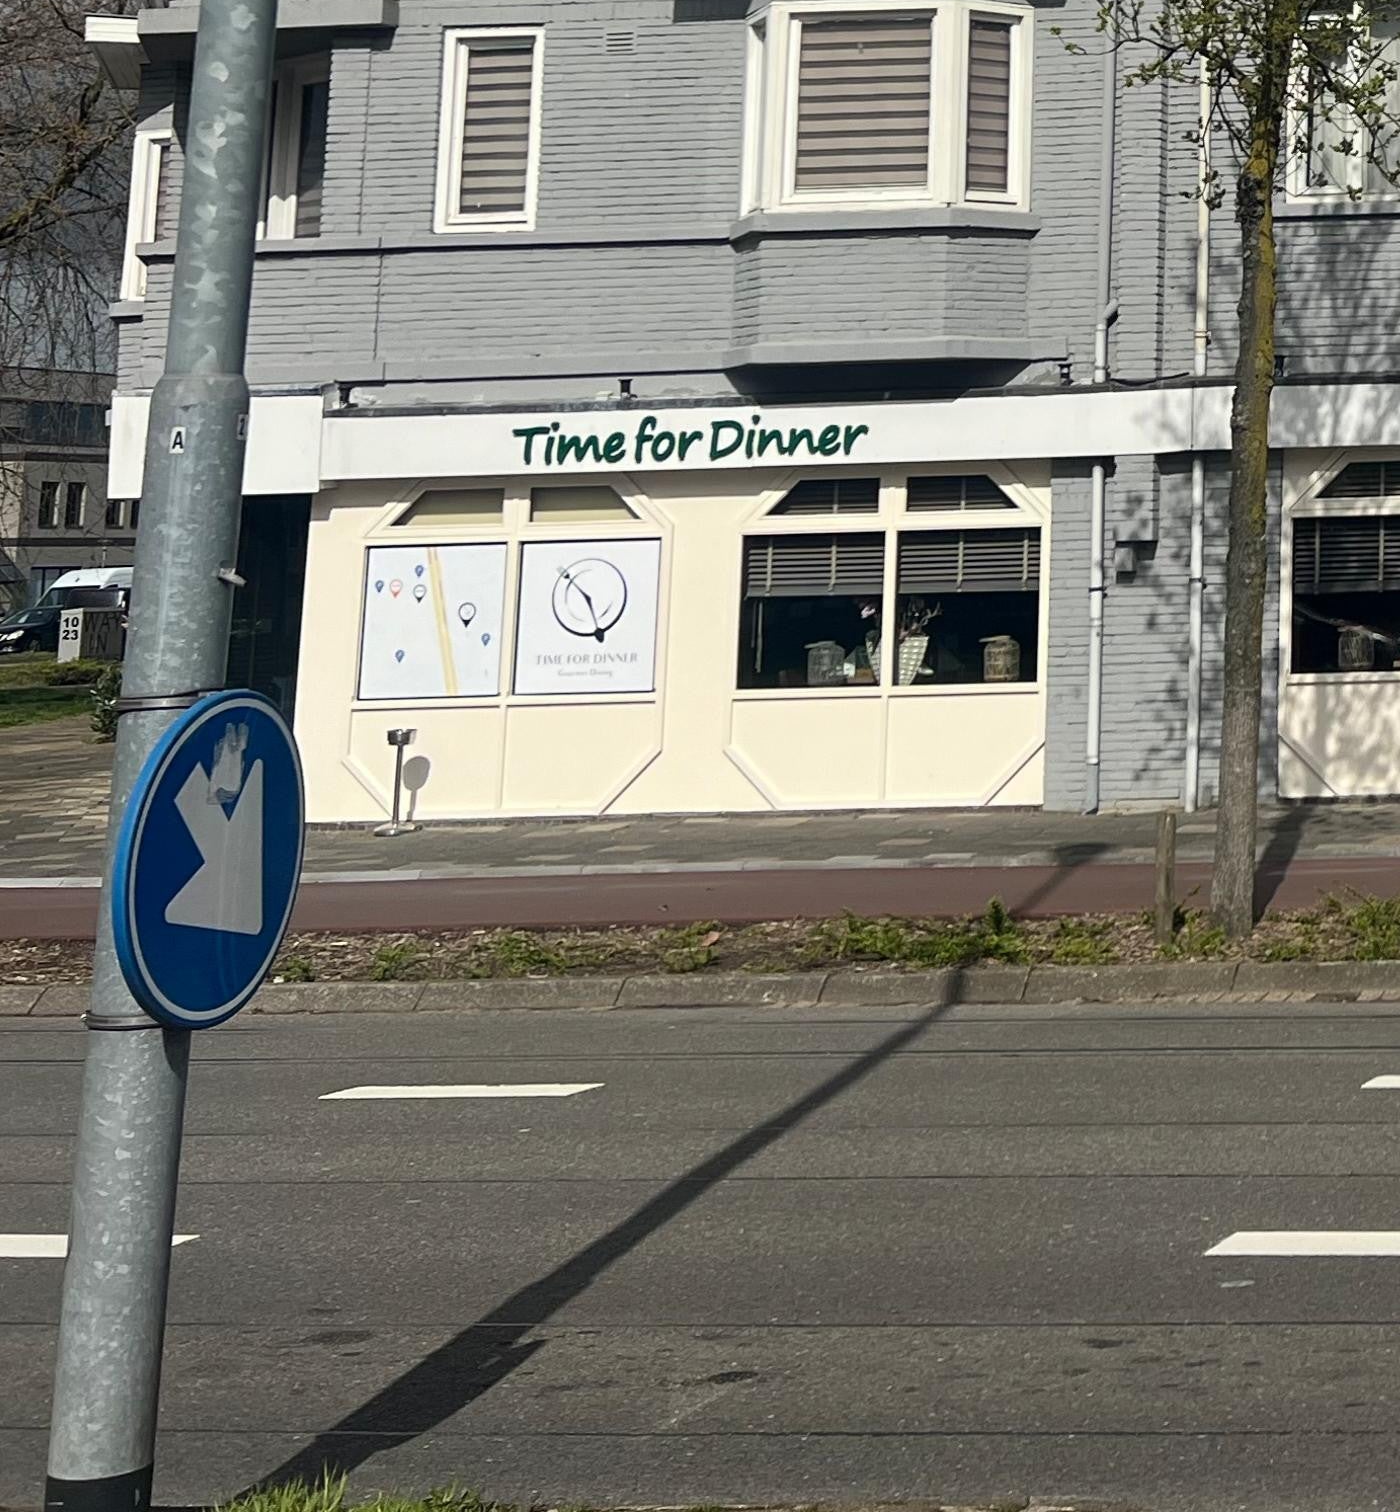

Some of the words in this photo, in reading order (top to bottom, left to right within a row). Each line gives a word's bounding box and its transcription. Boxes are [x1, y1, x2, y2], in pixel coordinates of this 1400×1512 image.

[172, 430, 184, 449] A
[512, 421, 626, 465] Time
[634, 415, 703, 464] for
[709, 414, 870, 462] Dinner
[63, 616, 79, 628] 10
[62, 629, 79, 641] 23
[536, 654, 562, 665] TIME
[566, 654, 590, 664] FOR
[593, 653, 638, 664] DINNER
